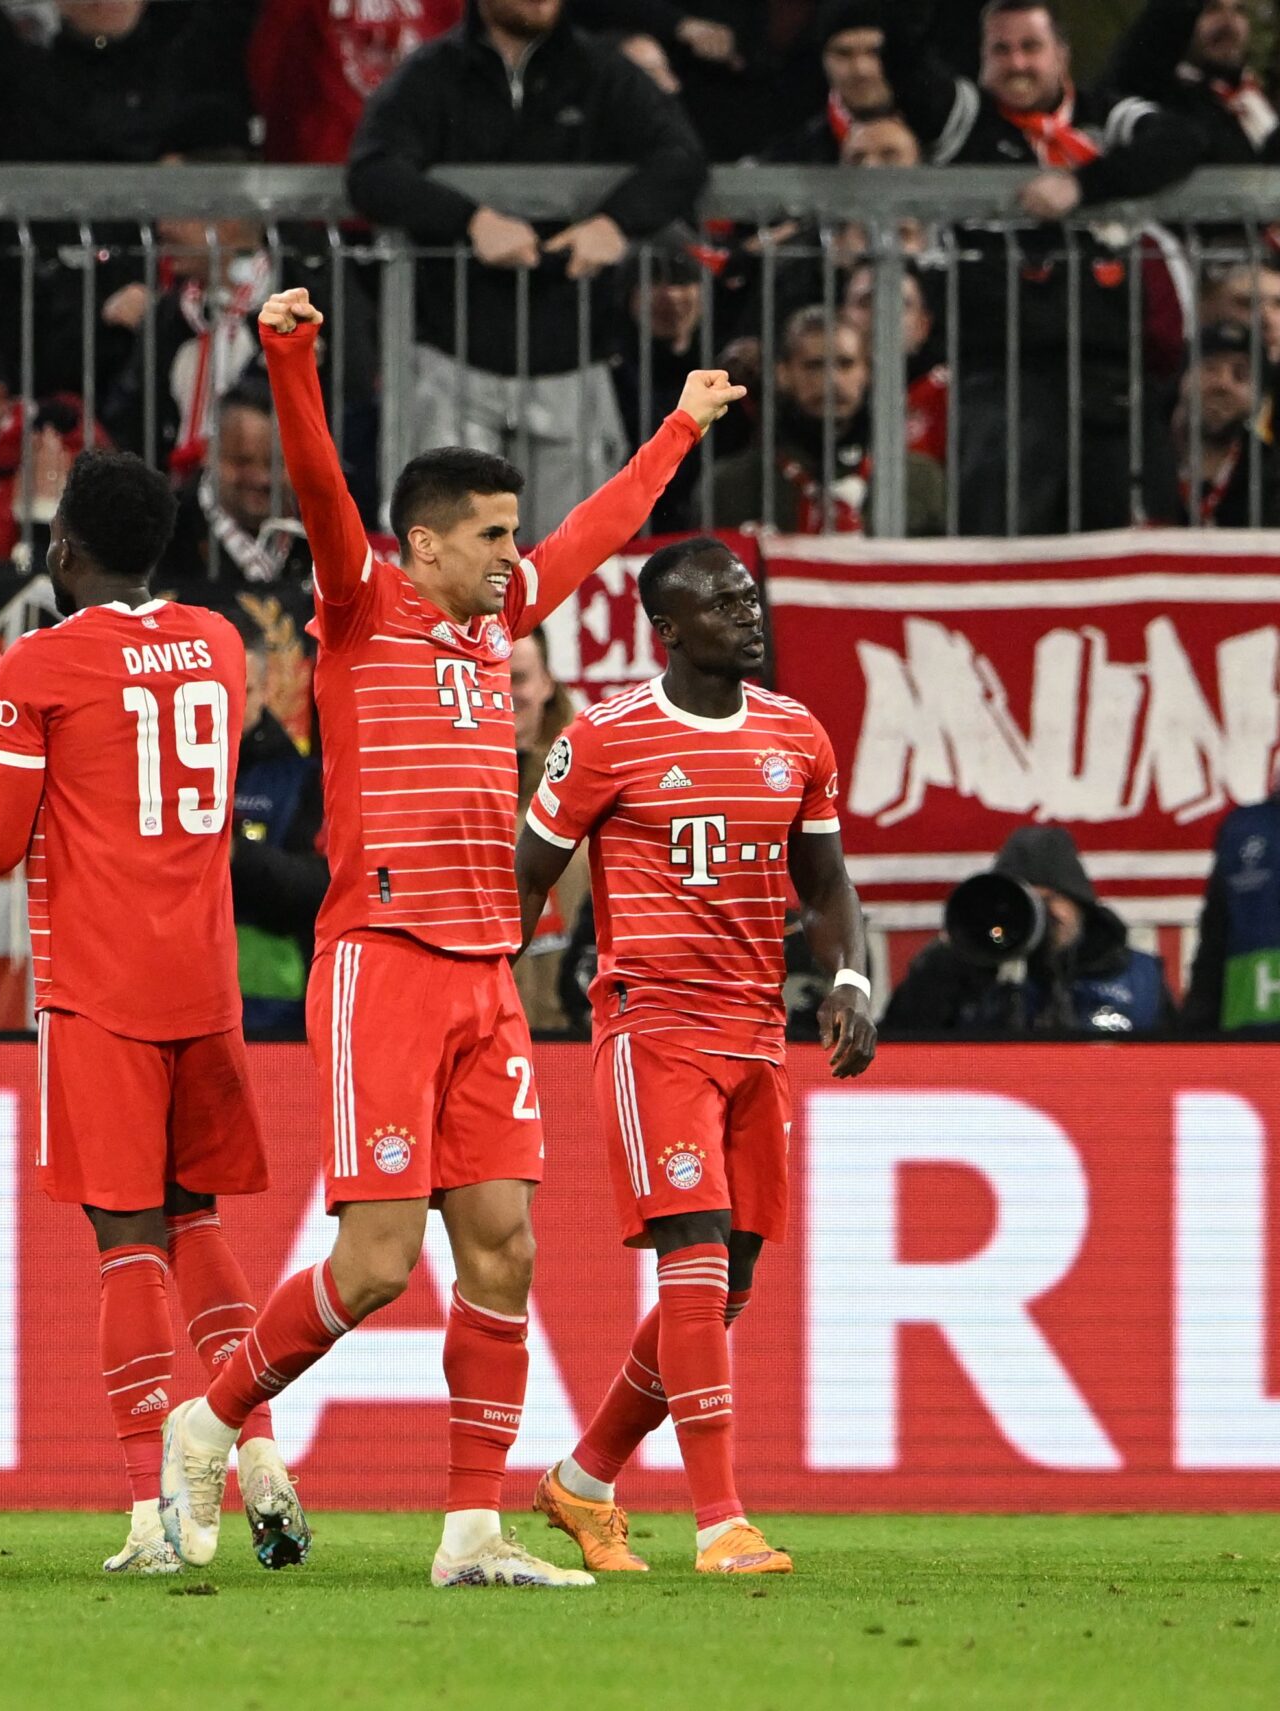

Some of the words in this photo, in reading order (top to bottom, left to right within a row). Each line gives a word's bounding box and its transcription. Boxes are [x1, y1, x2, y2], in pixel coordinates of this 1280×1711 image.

[122, 639, 212, 676] DAVIES
[122, 680, 229, 837] 19
[659, 777, 692, 789] adidas
